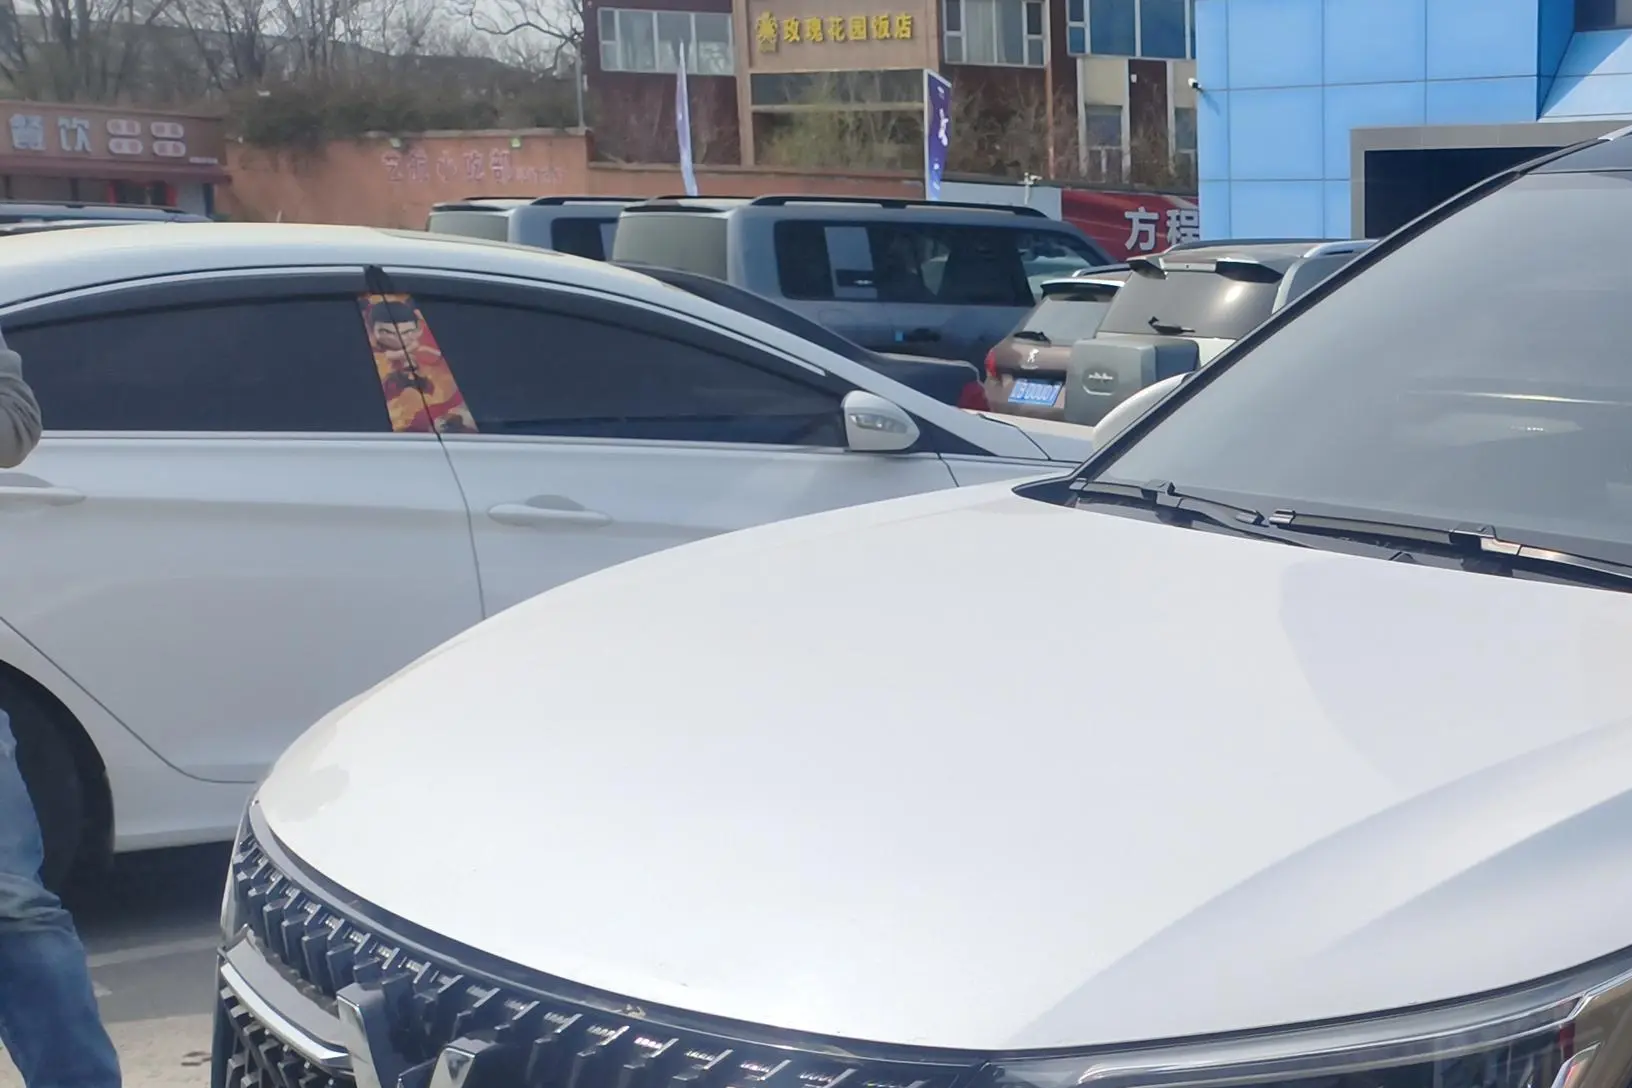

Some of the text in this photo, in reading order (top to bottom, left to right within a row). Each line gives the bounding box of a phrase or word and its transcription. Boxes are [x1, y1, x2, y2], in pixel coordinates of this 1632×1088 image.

[783, 12, 912, 42] 玫瑰花园饭店
[1124, 206, 1199, 250] 方程
